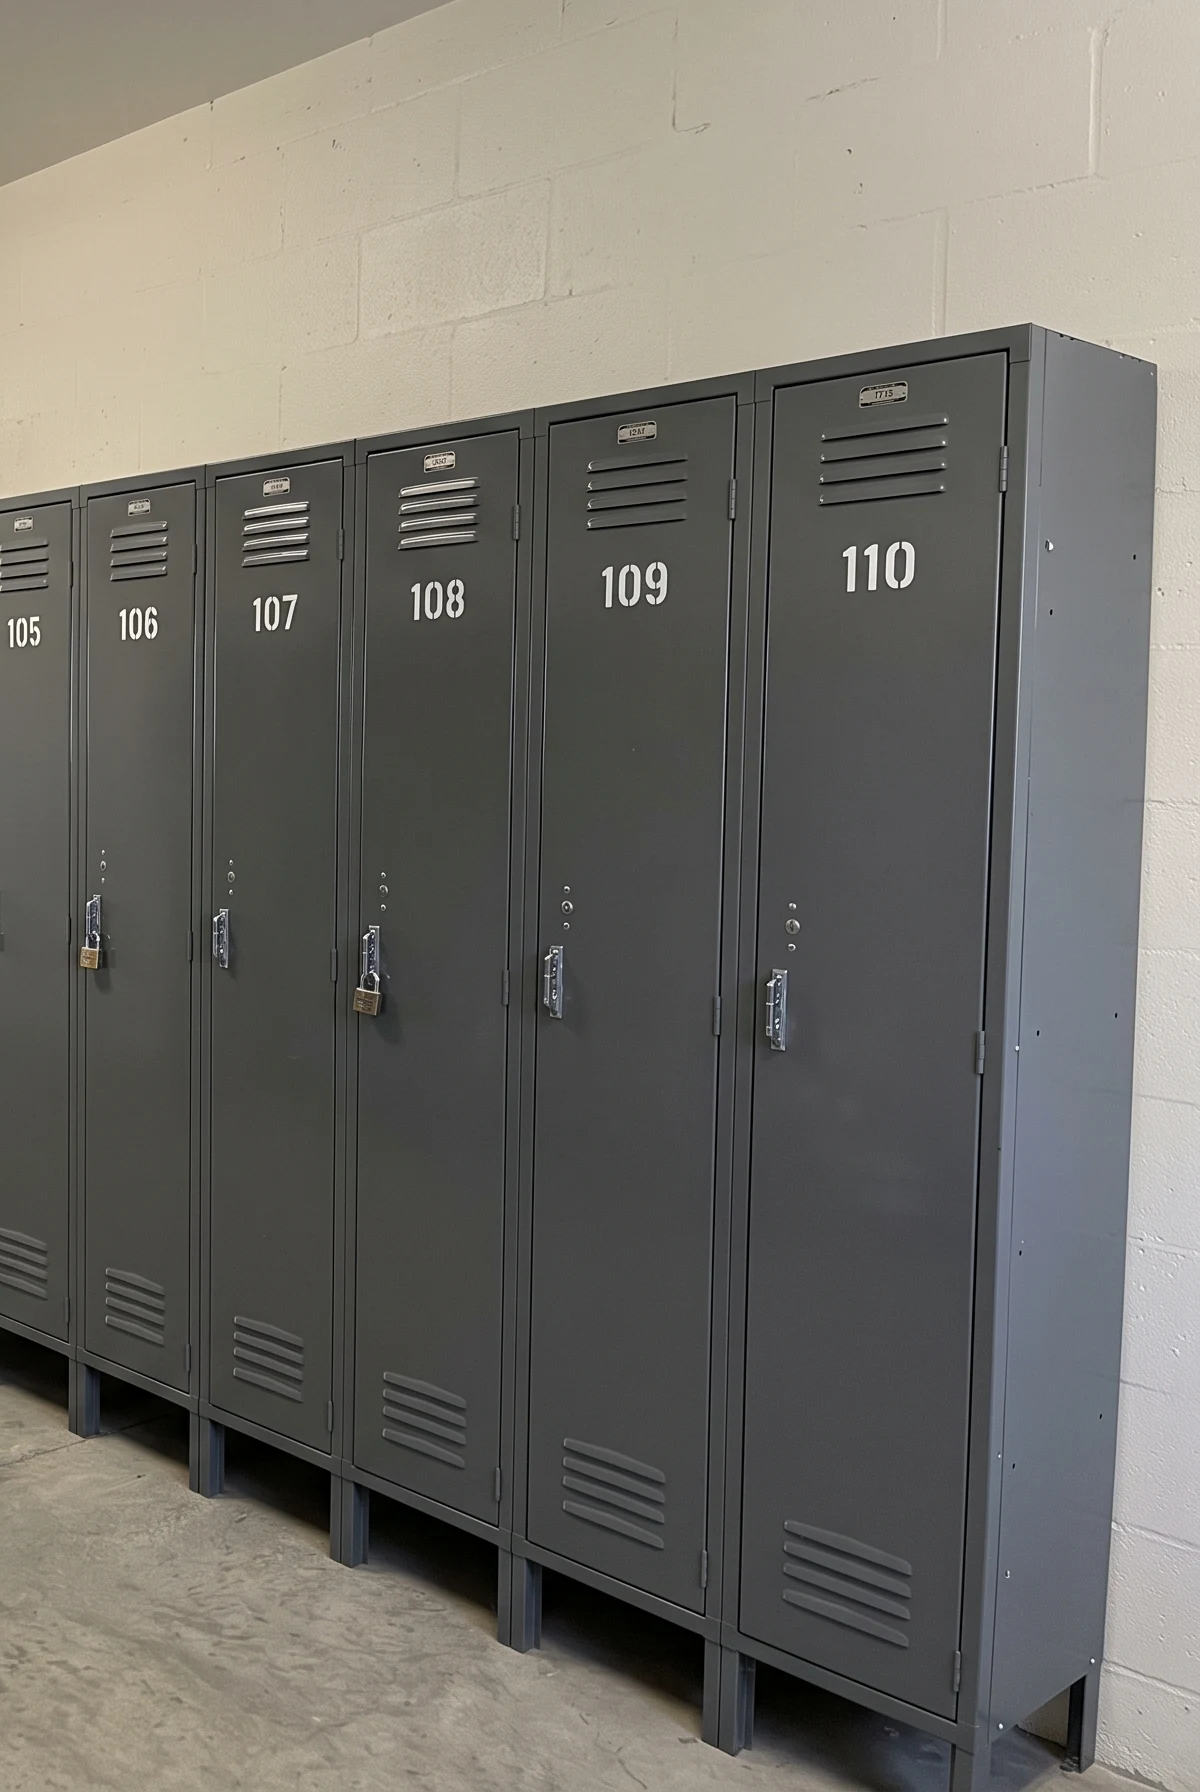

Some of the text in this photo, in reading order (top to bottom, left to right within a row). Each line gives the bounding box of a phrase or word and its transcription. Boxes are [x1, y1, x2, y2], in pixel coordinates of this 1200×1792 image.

[601, 561, 668, 608] 109
[842, 541, 916, 593] 110
[252, 593, 299, 632] 107
[410, 578, 465, 621] 108
[7, 615, 41, 648] 105
[119, 606, 159, 641] 106
